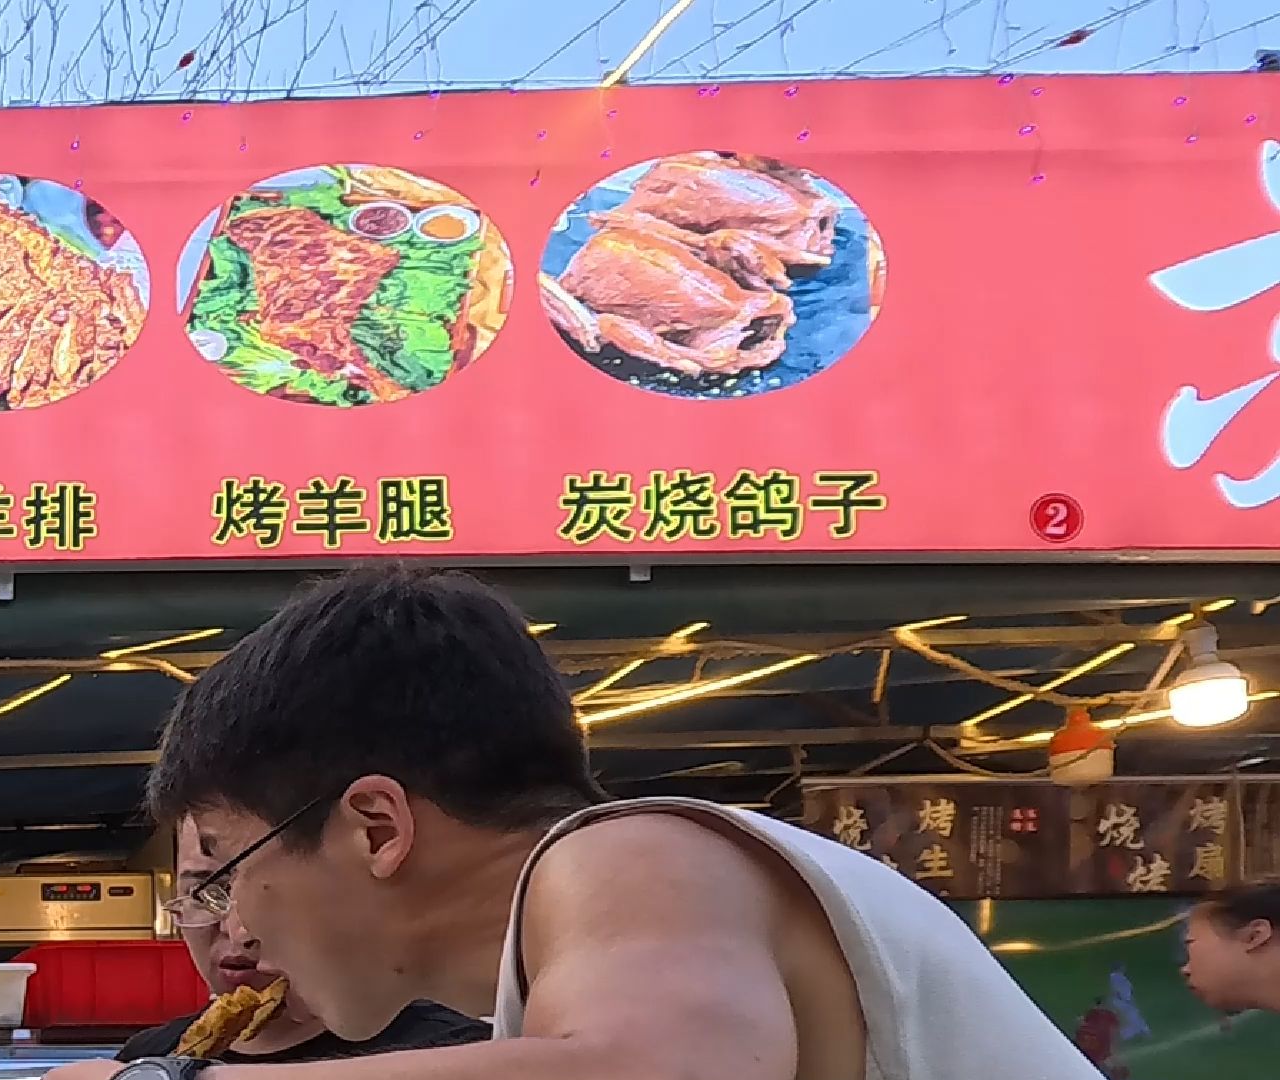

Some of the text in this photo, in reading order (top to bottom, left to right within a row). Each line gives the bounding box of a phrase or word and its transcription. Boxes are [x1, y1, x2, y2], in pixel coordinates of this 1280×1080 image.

[211, 475, 453, 549] 烤羊腿
[558, 469, 887, 544] 炭烧鸽子
